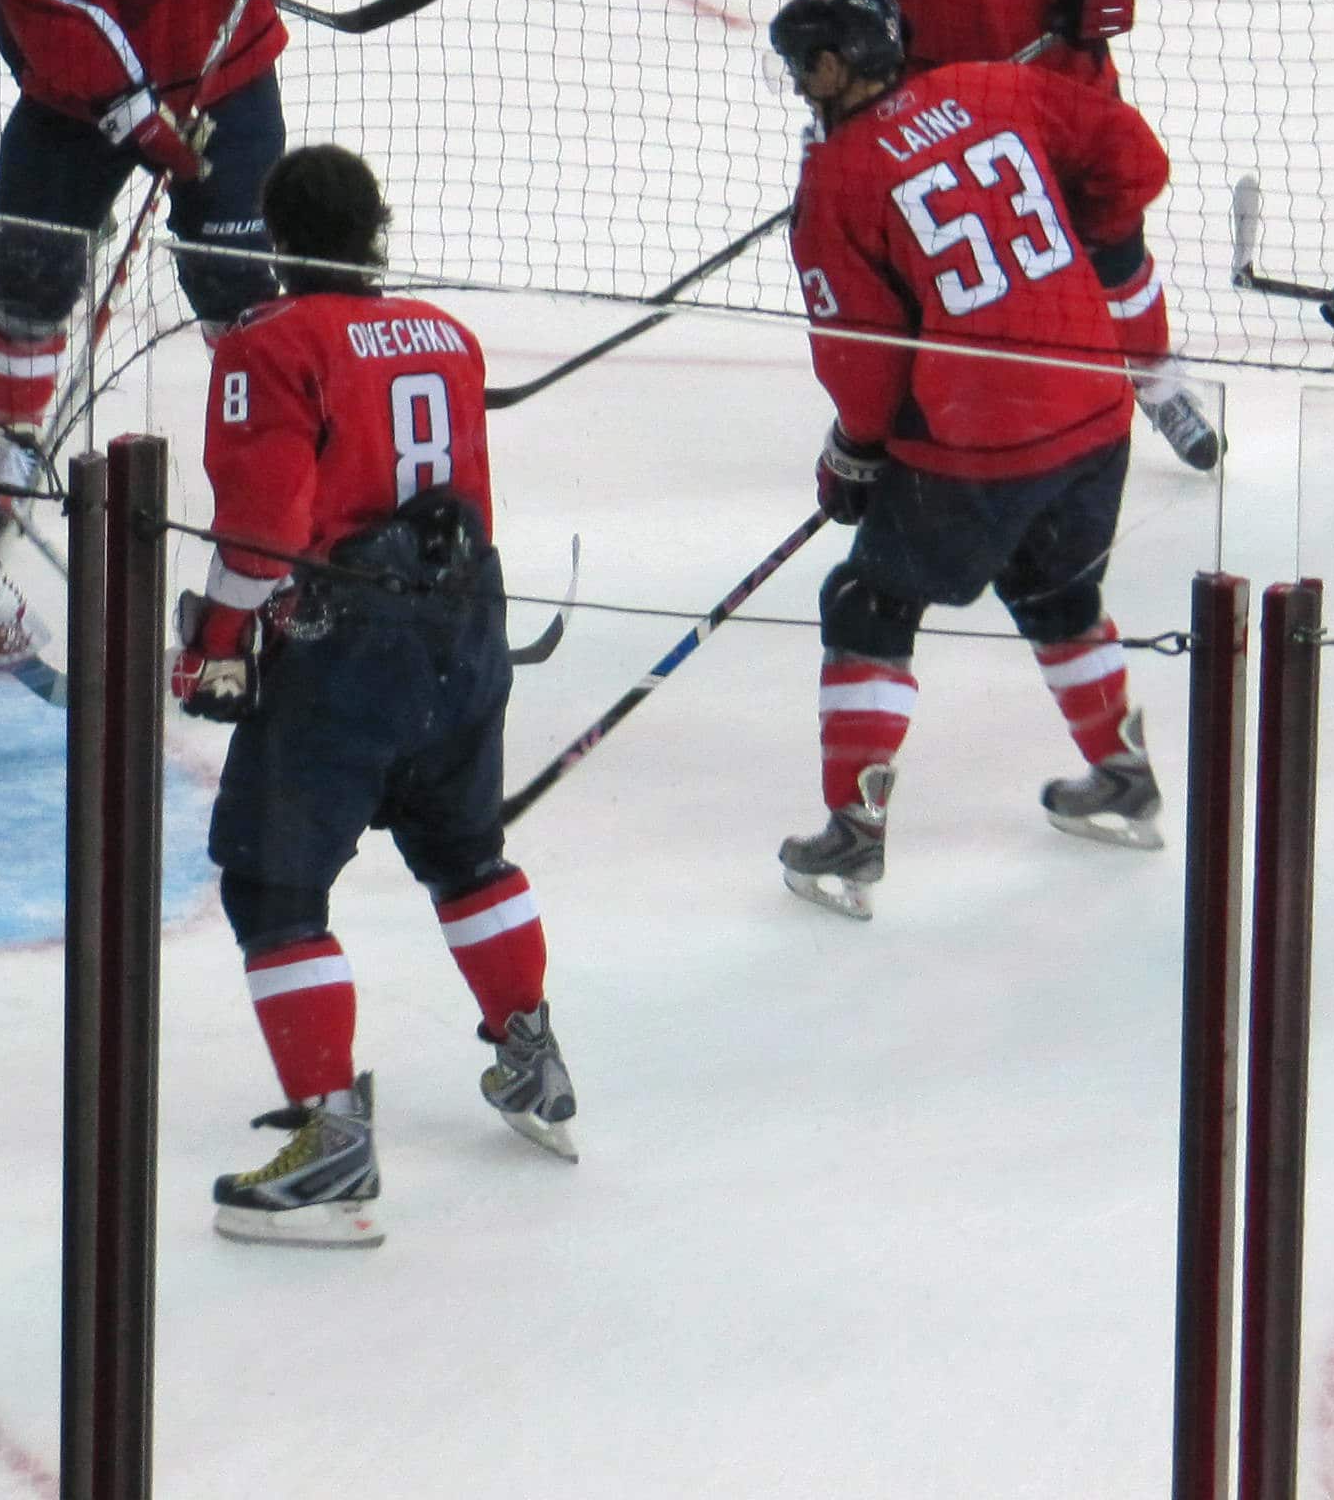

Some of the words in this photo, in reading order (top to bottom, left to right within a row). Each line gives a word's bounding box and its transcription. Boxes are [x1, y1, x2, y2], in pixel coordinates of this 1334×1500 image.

[876, 98, 973, 162] LAING
[891, 130, 1073, 316] 53
[223, 371, 249, 424] 8
[390, 372, 454, 508] 8
